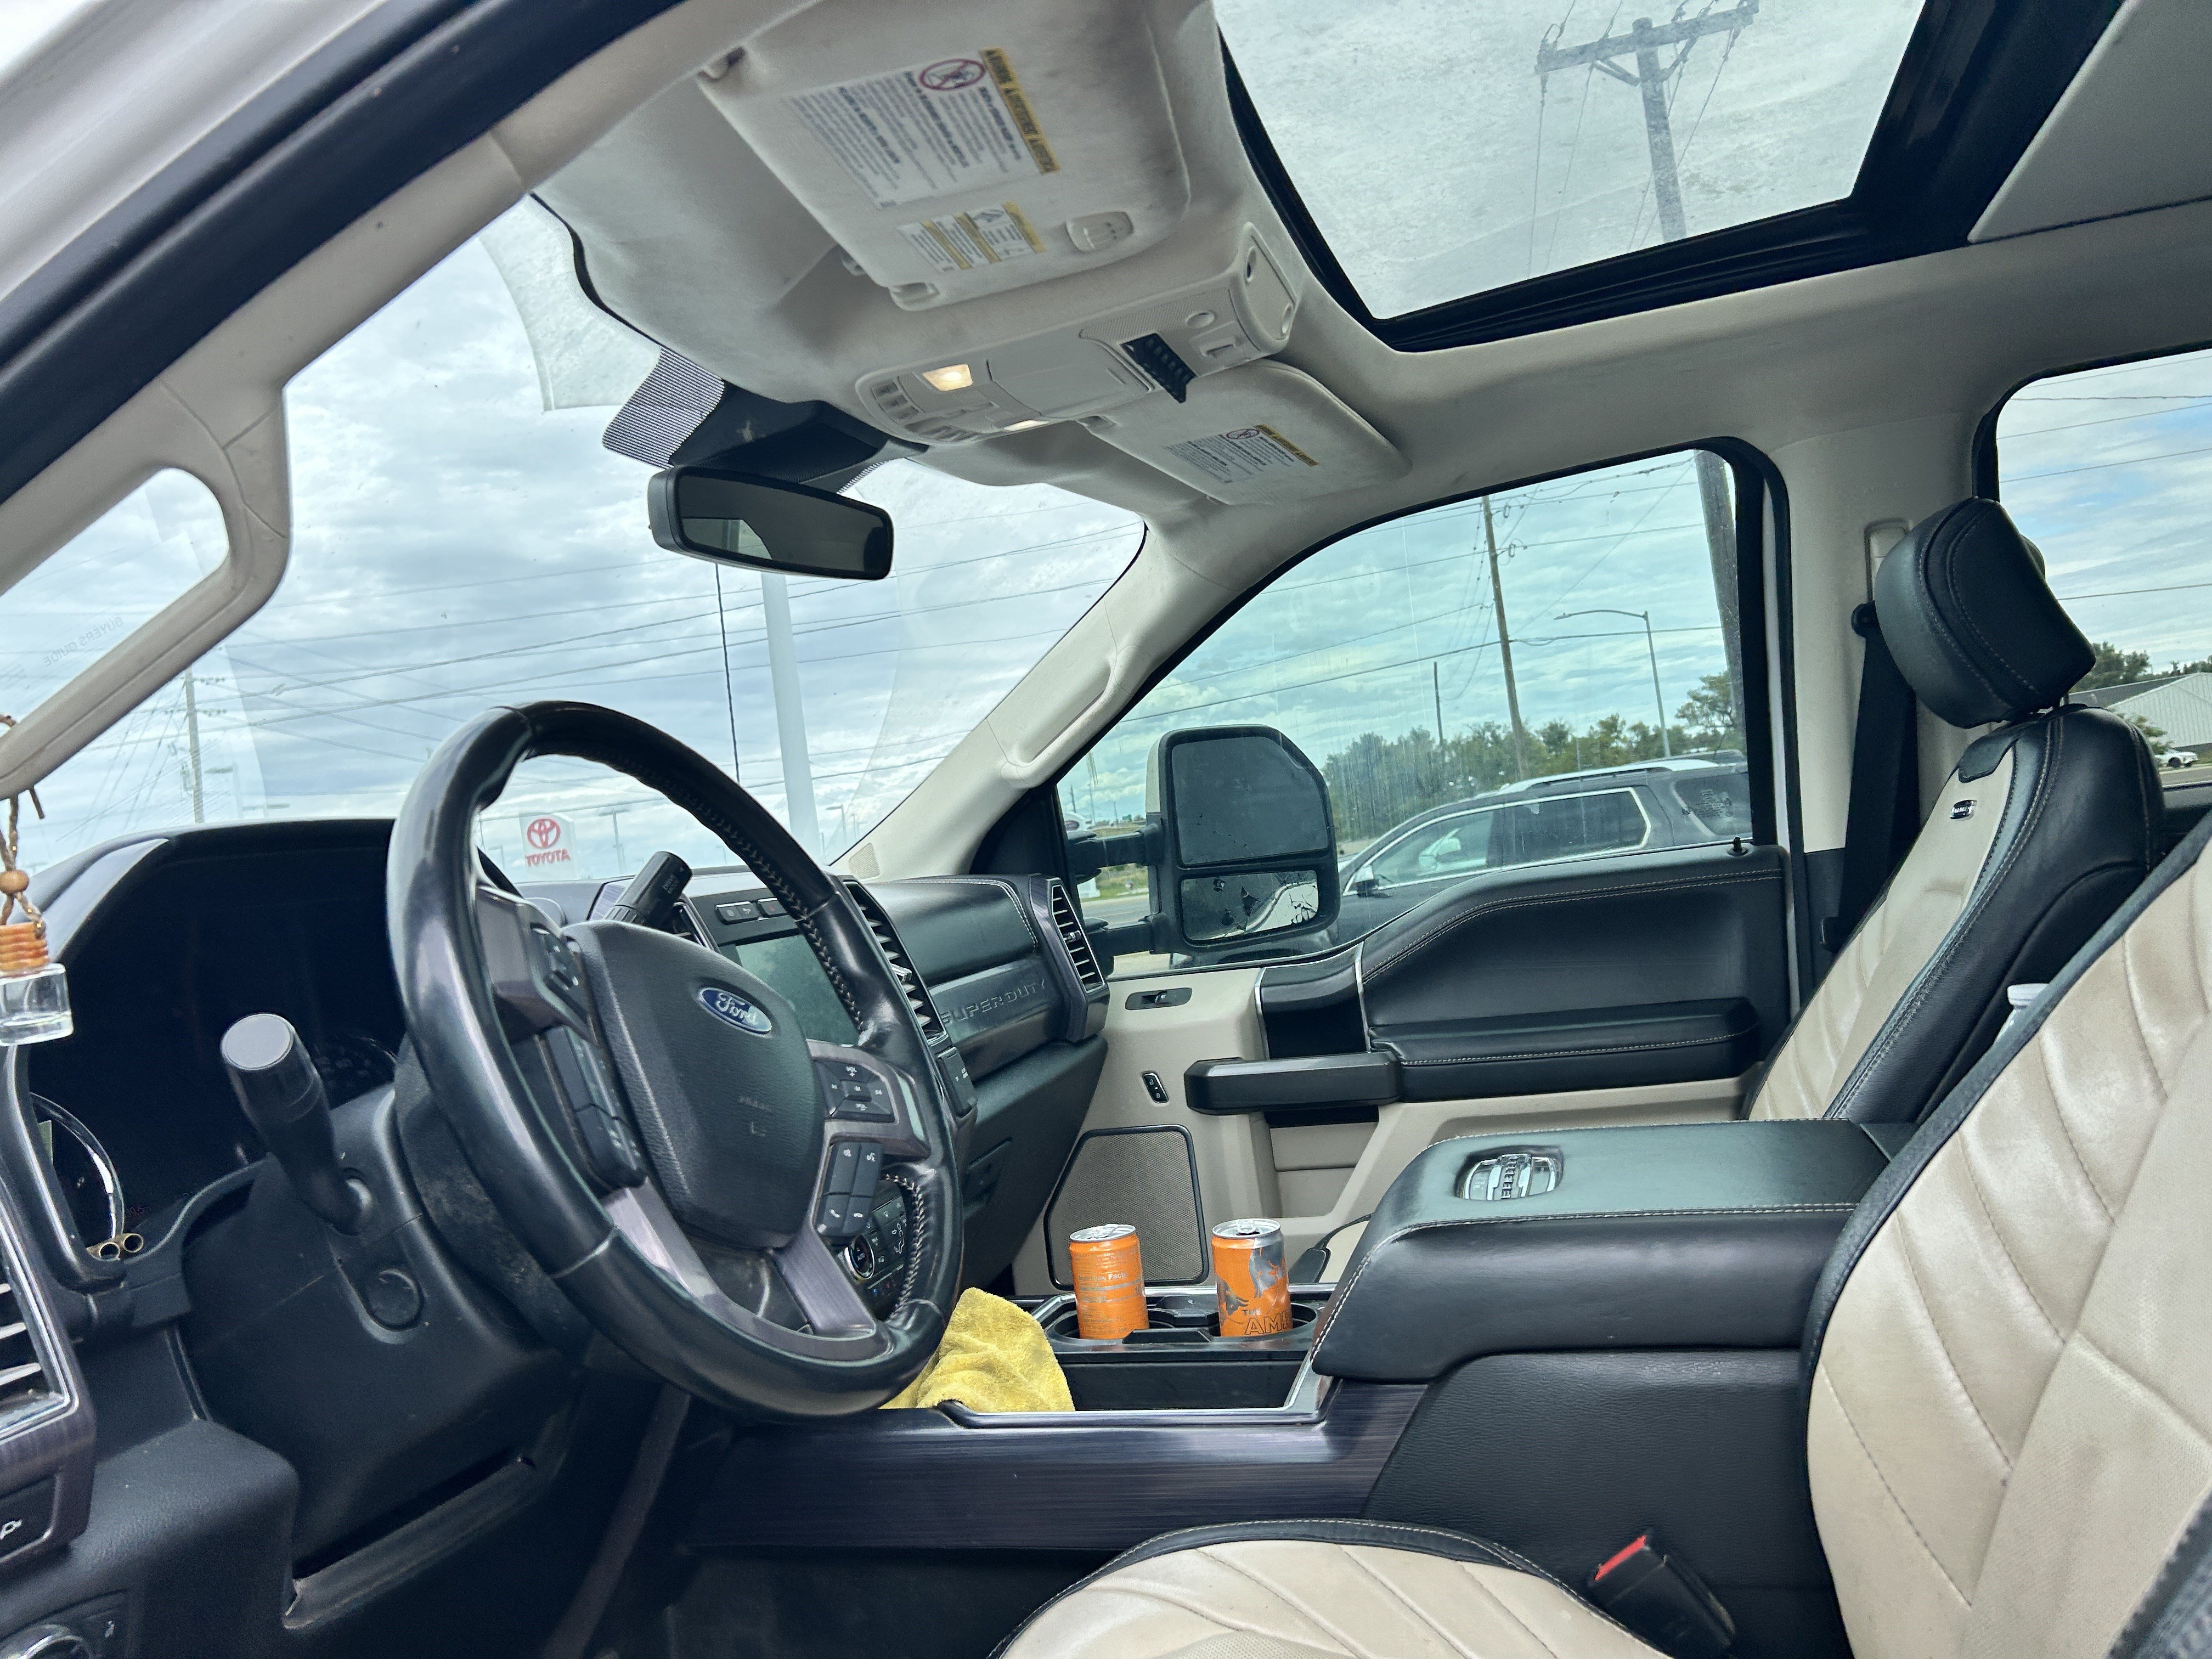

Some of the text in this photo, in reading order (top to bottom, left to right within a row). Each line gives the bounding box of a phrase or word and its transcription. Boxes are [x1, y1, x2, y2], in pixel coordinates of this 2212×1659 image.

[524, 847, 571, 867] TOYOTA
[715, 991, 759, 1026] Ford
[940, 979, 1045, 1025] SUPER DUTY
